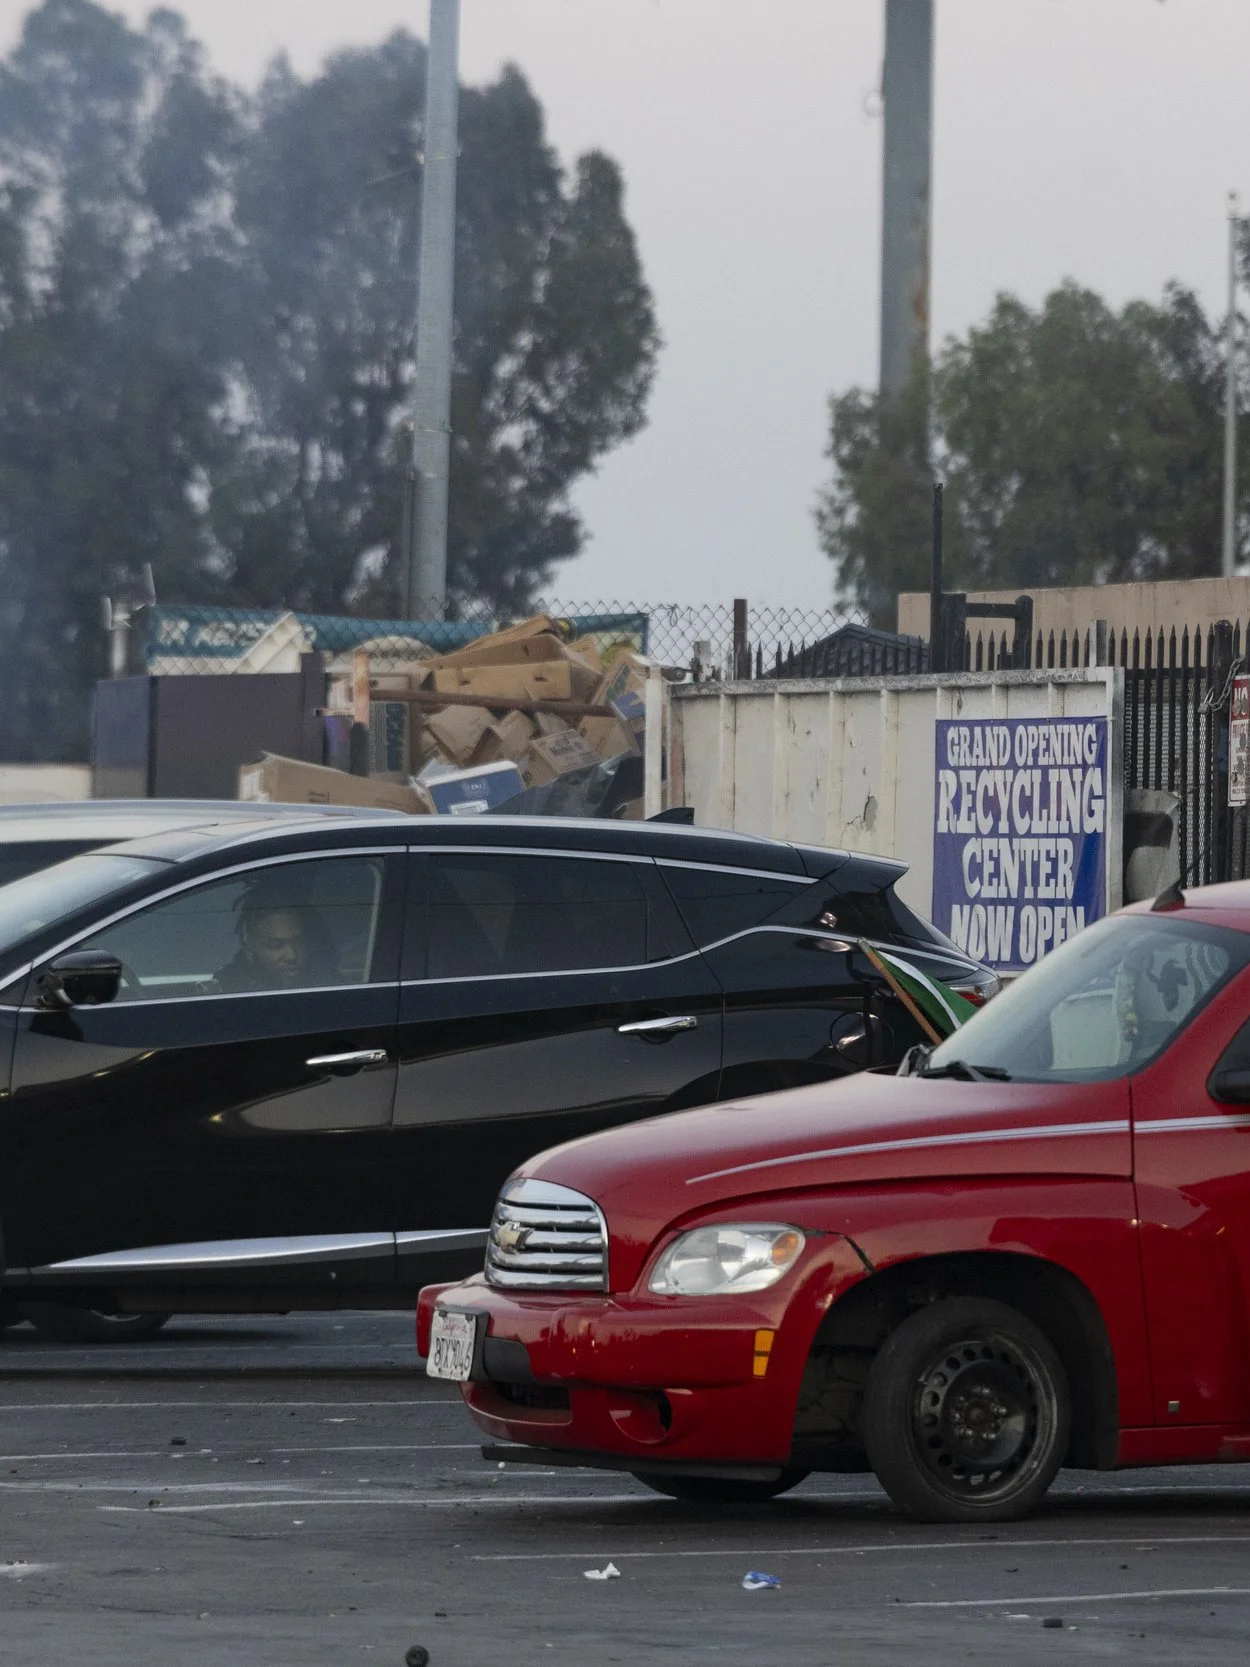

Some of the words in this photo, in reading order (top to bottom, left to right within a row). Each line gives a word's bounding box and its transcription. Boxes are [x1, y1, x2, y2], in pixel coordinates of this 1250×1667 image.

[947, 725, 1012, 767] GRAND
[1014, 723, 1098, 767] OPENING
[936, 767, 1105, 836] RECYCLING
[962, 836, 1075, 900] CENTER
[951, 904, 1016, 963] NOW
